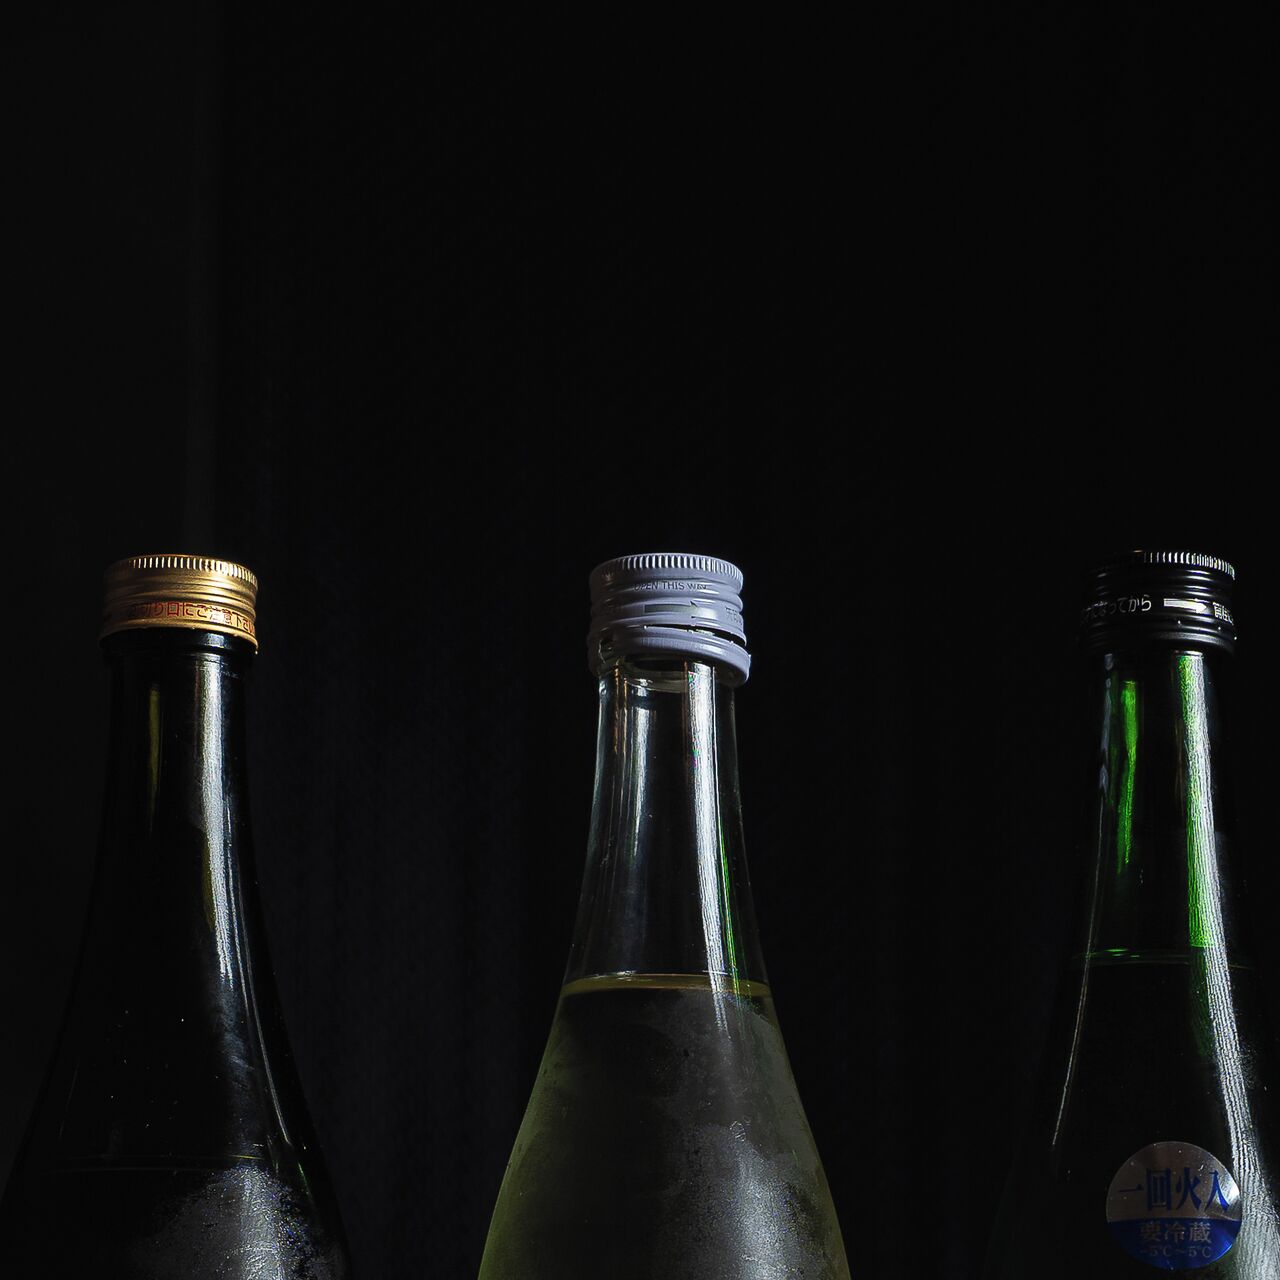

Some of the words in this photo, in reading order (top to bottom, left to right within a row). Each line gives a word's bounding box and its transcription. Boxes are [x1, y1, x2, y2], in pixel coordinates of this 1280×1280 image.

[662, 582, 685, 591] THIS
[1140, 1221, 1213, 1244] 要冷蔵
